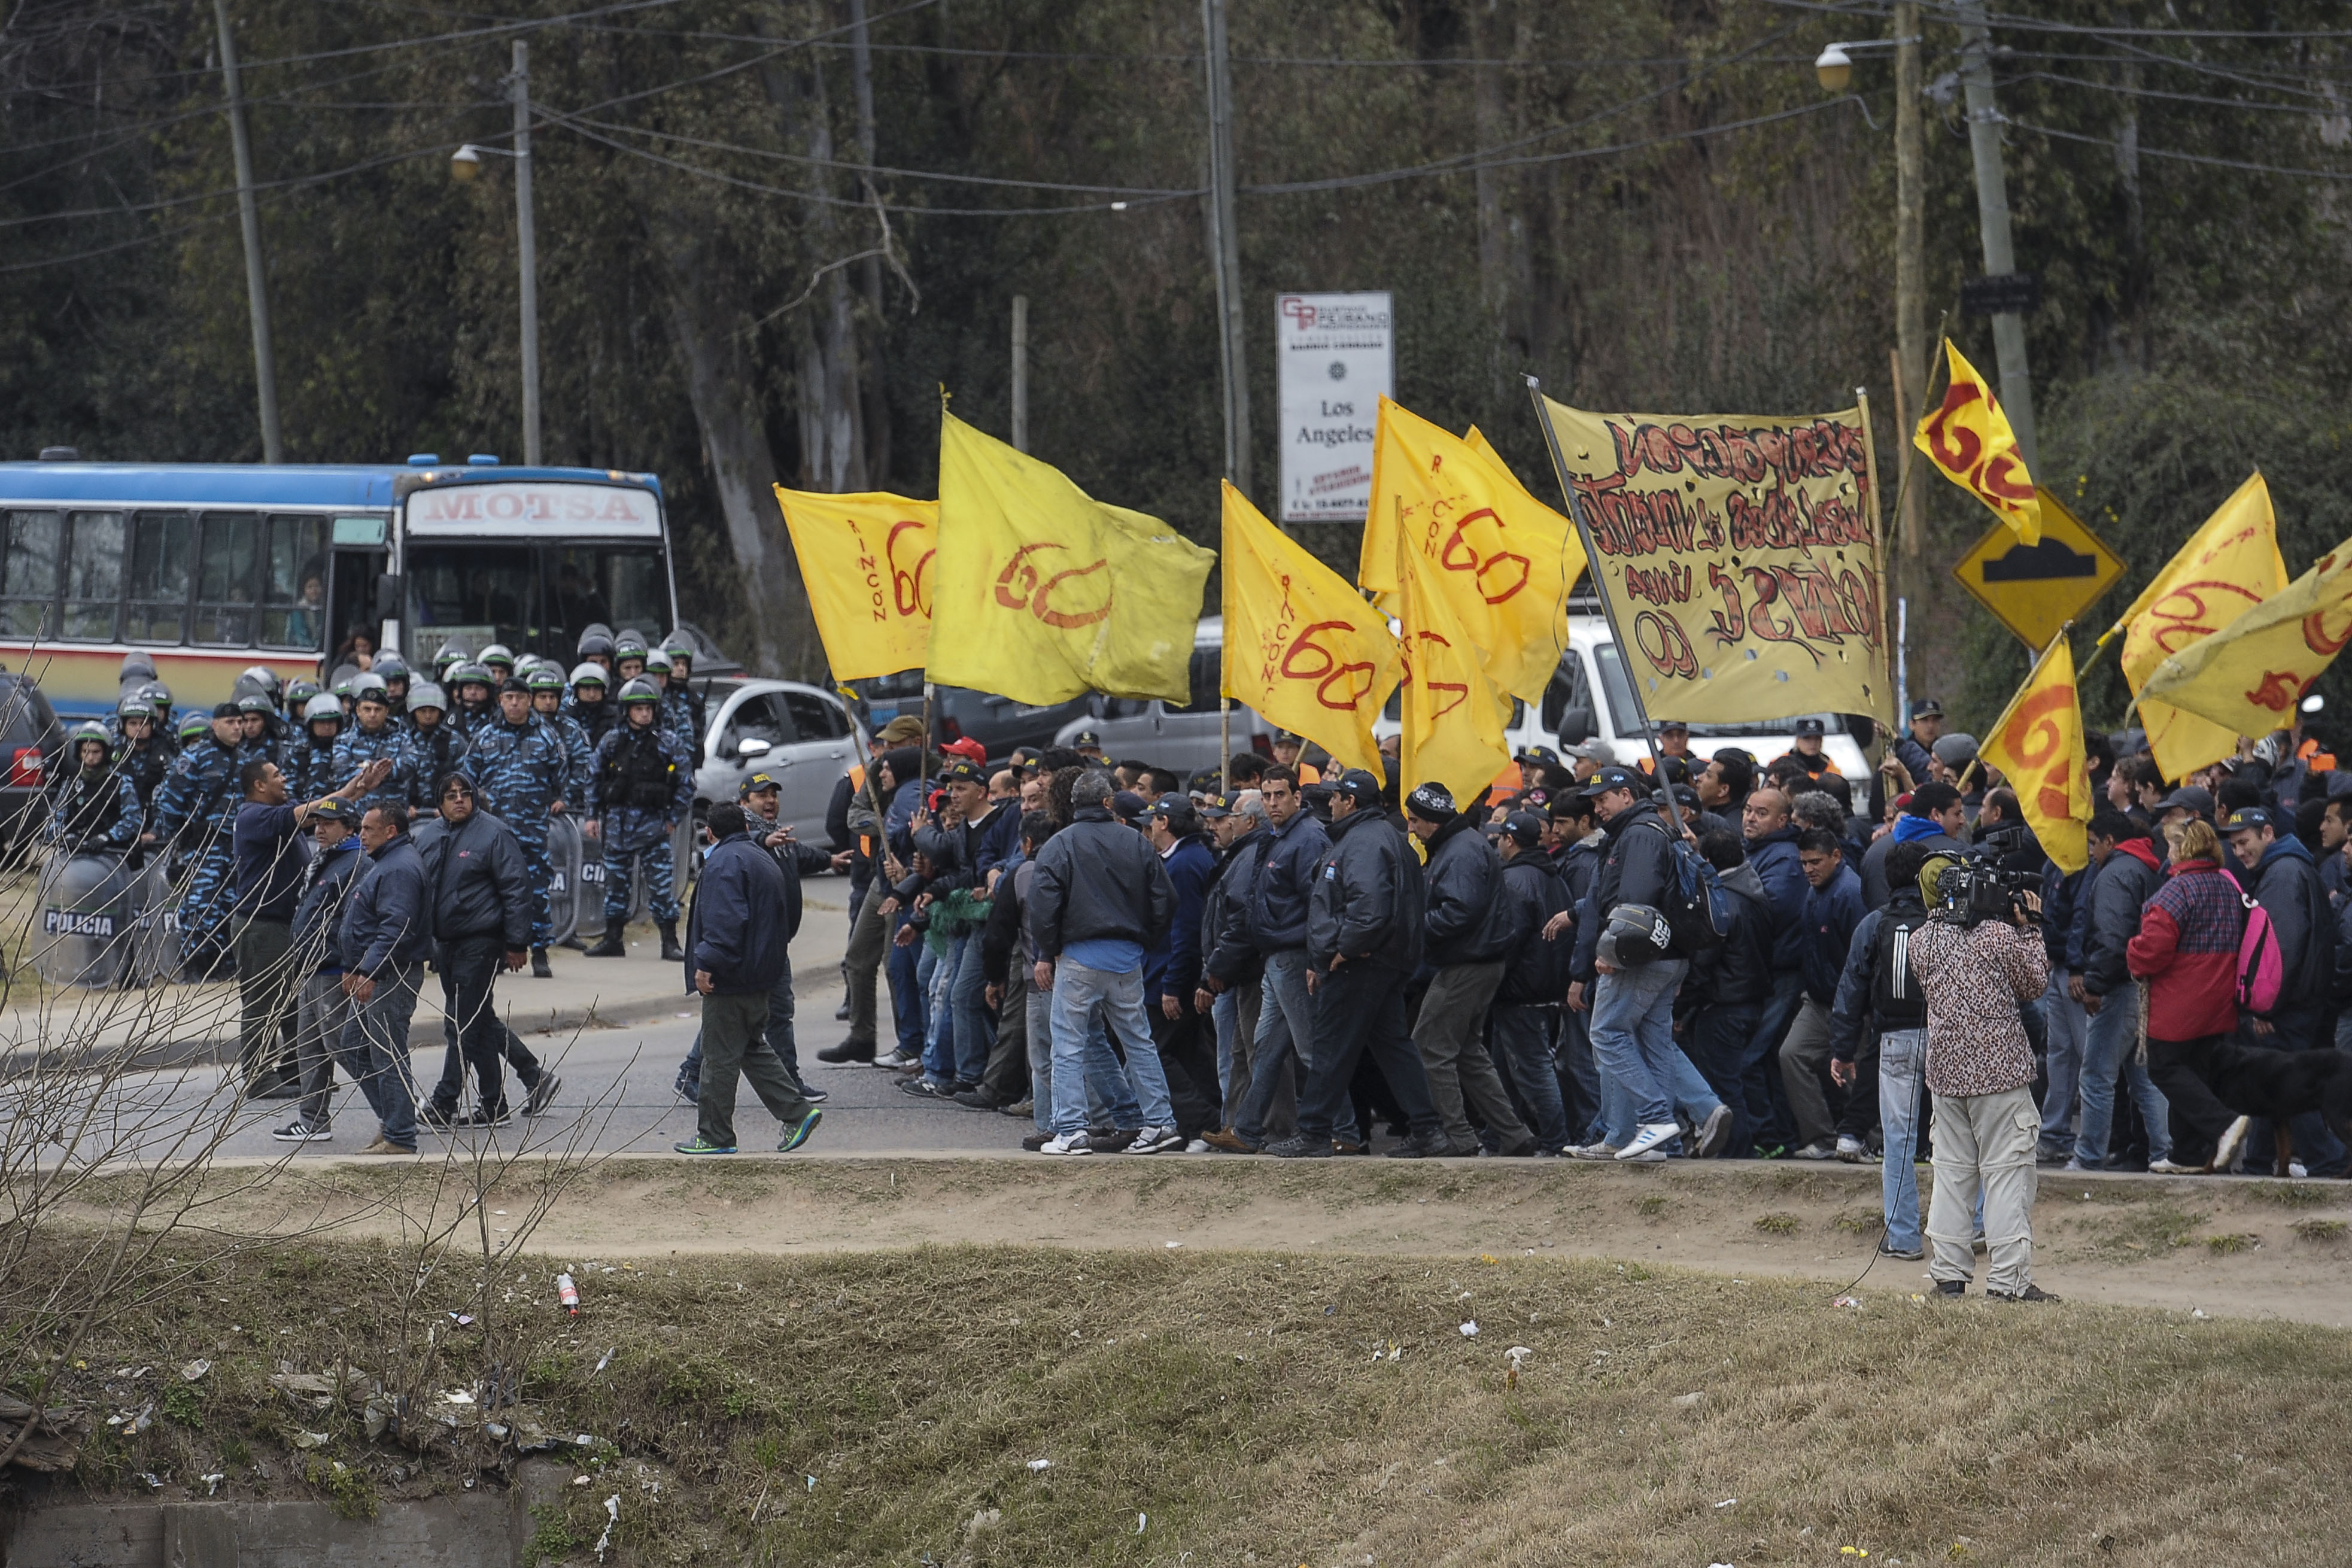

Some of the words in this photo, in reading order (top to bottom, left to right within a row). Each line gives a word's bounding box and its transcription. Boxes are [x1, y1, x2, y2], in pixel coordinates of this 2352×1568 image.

[1297, 426, 1375, 448] Angeles
[1322, 400, 1354, 417] Los
[424, 493, 639, 521] MOTSA
[847, 519, 886, 622] RINCON
[1442, 508, 1530, 604] 60
[996, 543, 1113, 629] 60
[1281, 621, 1375, 711] 60
[46, 911, 113, 937] POLICIA
